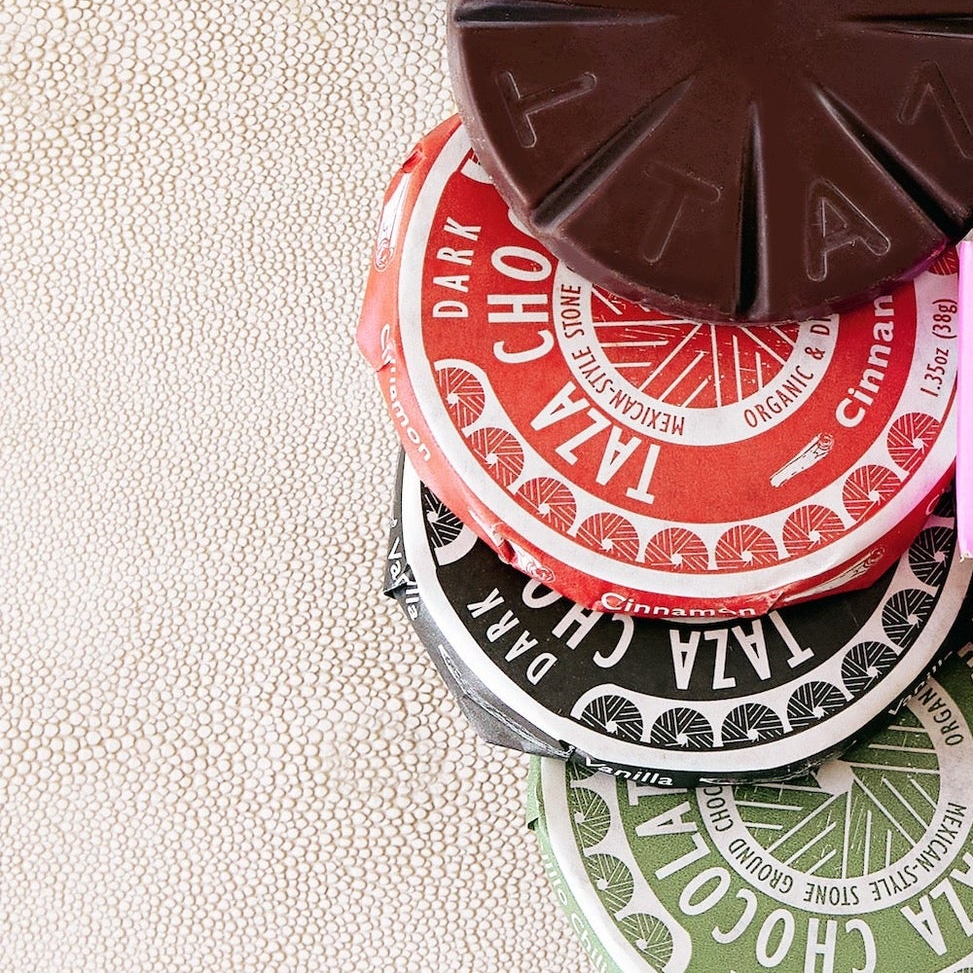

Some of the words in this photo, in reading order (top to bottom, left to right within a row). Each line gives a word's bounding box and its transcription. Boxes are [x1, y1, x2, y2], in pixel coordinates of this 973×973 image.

[432, 216, 482, 318] DARK
[560, 283, 585, 339] STONE
[932, 298, 958, 340] (38g)
[571, 345, 685, 436] MEXICAN-STYLE
[744, 365, 814, 428] ORGANIC
[804, 346, 825, 361] &
[835, 294, 895, 428] Cinnam
[920, 347, 949, 397] 1.35oz
[530, 380, 661, 505] TAZA
[466, 587, 558, 685] DARK
[669, 611, 815, 691] TAZA
[917, 686, 964, 747] ORGAN
[585, 756, 674, 787] Vanilla
[628, 780, 877, 973] CHOCOLAT
[728, 836, 793, 895] GROUND
[872, 802, 967, 901] MEXICAN-STYLE
[804, 882, 860, 907] STONE
